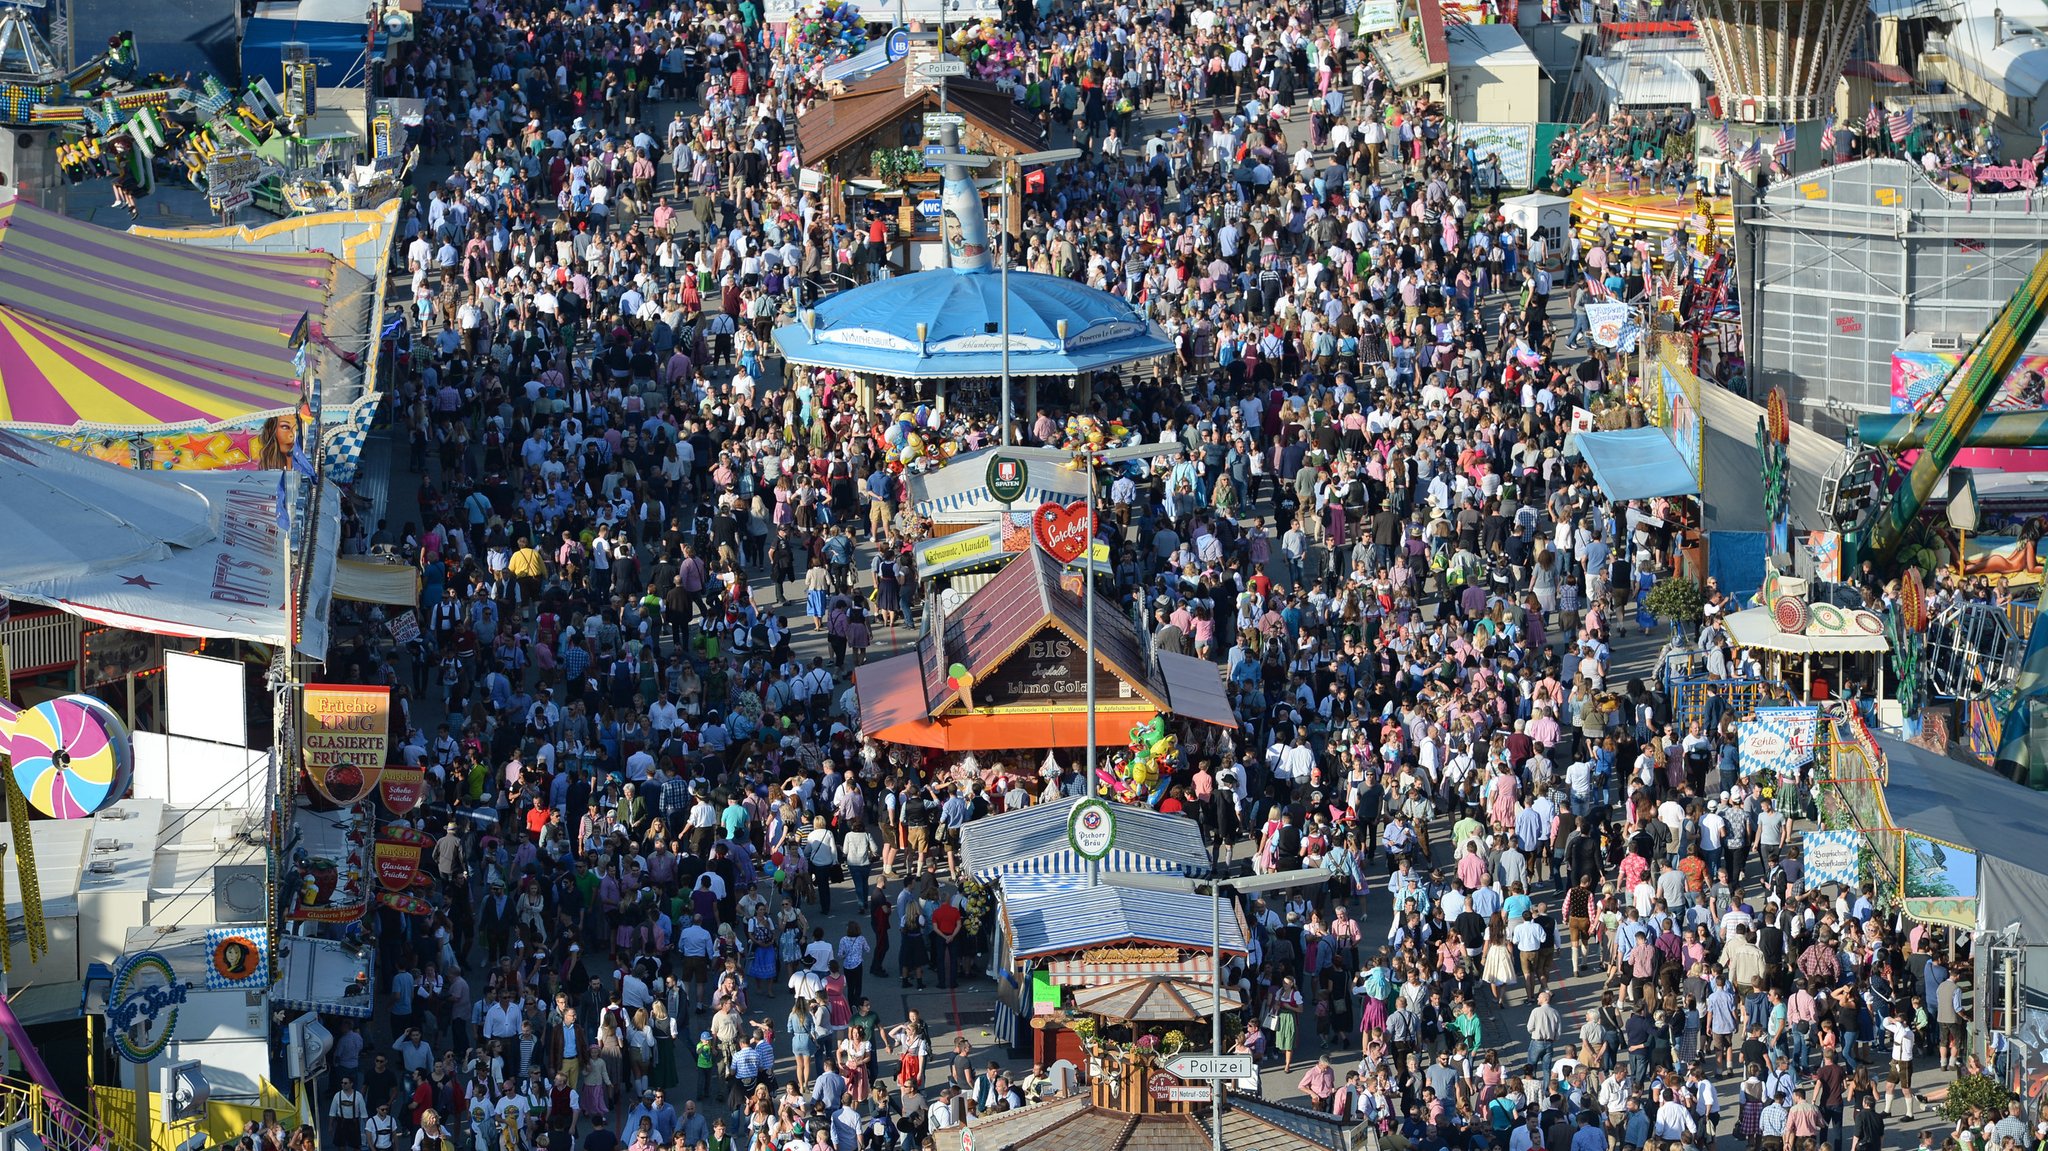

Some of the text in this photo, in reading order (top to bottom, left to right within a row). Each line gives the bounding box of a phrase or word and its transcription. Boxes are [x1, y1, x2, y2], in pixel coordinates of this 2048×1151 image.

[929, 62, 960, 73] Polizei
[925, 203, 940, 212] WC
[927, 539, 990, 563] Gebrannte Mandeln
[1028, 640, 1072, 658] EIS
[1008, 680, 1088, 694] Limo Cola
[318, 697, 377, 714] Früchte
[321, 714, 374, 732] KRUG
[307, 735, 384, 750] GLASIERTE
[313, 751, 378, 766] FRÜCHTE
[384, 771, 419, 782] Angebot
[389, 785, 414, 794] Schoko-
[388, 793, 412, 802] Früchte
[1079, 831, 1105, 840] Pschorr
[1083, 839, 1101, 847] Bräu
[380, 846, 418, 858] Angebot
[381, 861, 411, 871] Glasierte
[383, 870, 408, 880] Früchte
[307, 909, 359, 919] Glasierte Früchte
[140, 985, 187, 1020] Spin
[1190, 1060, 1243, 1073] Polizei
[1171, 1090, 1210, 1098] 21 Notruf-SOS
